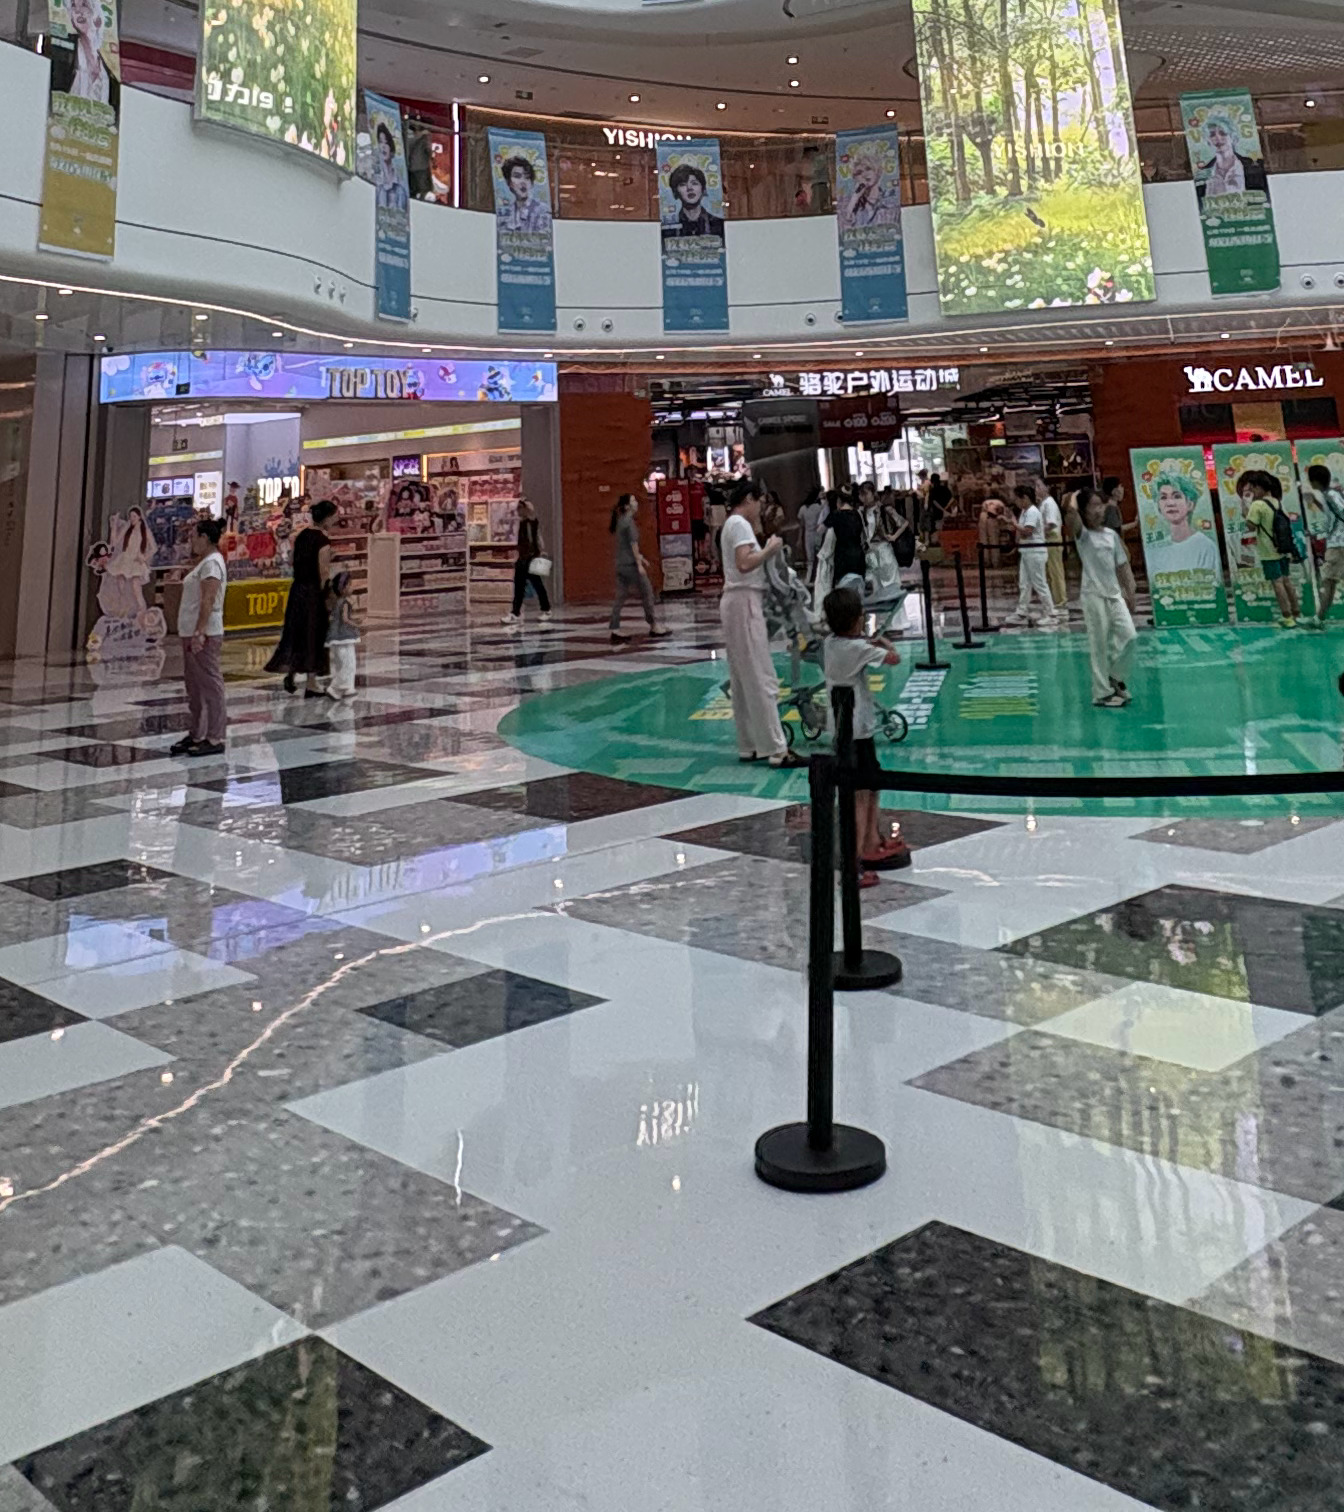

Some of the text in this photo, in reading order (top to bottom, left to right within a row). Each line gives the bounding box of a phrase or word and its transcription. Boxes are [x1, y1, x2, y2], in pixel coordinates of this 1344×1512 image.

[602, 128, 692, 149] YISH
[328, 368, 409, 399] TOP TOY
[799, 368, 961, 396] 骆驼户外运动城
[1213, 365, 1324, 392] CAMEL
[762, 389, 793, 397] CAMEL
[257, 477, 283, 506] TOP
[247, 592, 280, 616] TOP
